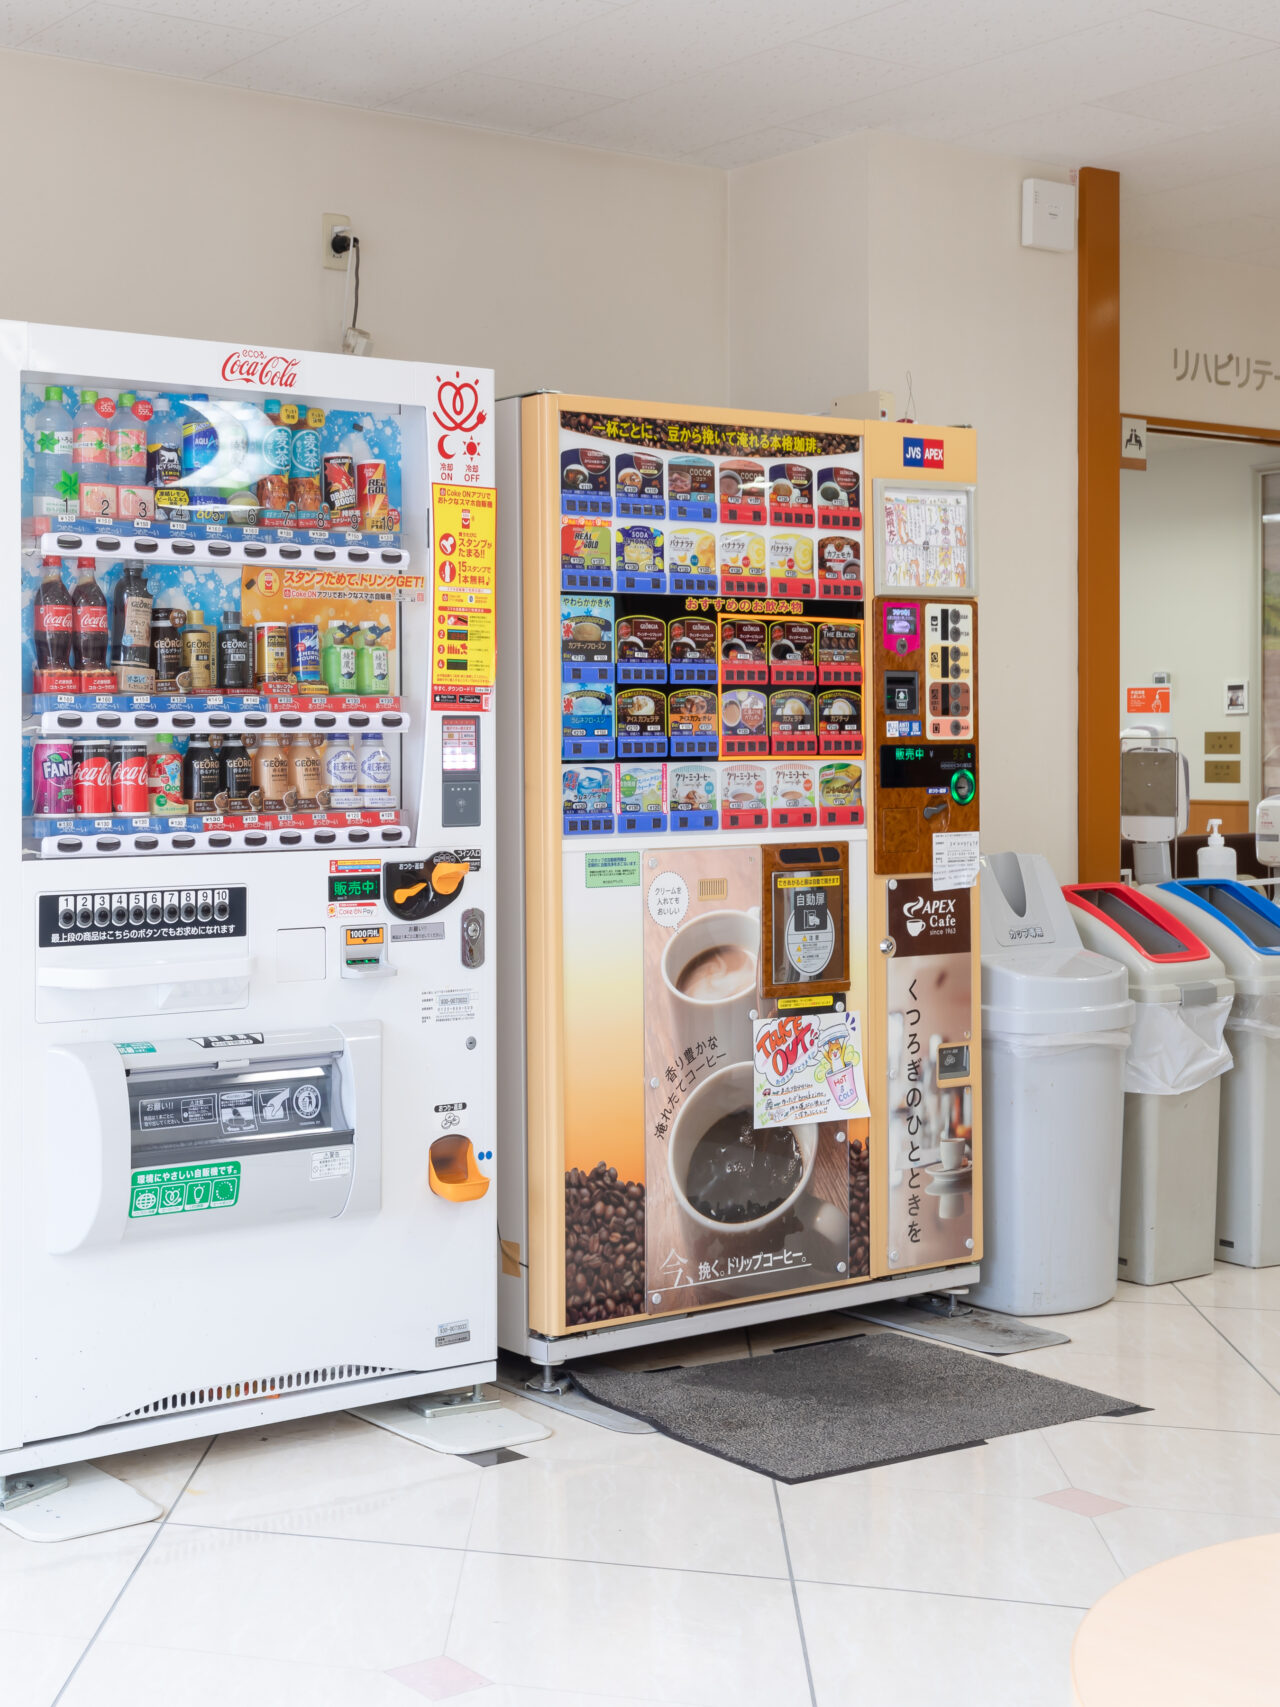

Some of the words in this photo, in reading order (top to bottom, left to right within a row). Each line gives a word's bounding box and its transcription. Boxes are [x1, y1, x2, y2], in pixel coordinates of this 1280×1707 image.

[221, 351, 302, 388] Coca-Cola
[276, 431, 290, 466] 麦茶
[304, 433, 318, 467] 麦茶
[905, 446, 921, 459] JVS
[924, 448, 943, 461] APEX
[441, 473, 453, 481] ON
[464, 473, 480, 482] OFF
[689, 468, 712, 477] COCOA
[101, 499, 110, 516] 2
[138, 501, 147, 518] 3
[175, 504, 184, 520] 4
[212, 506, 220, 522] 5
[248, 508, 257, 525] 6
[282, 510, 290, 525] 7
[317, 512, 325, 528] 8
[351, 514, 359, 529] 9
[381, 516, 394, 531] 10
[458, 538, 492, 549] スタンプが
[584, 541, 598, 549] GOLD
[670, 539, 695, 547] バナナラテ
[771, 544, 793, 552] バナナラテ
[458, 548, 485, 558] たまる!!
[827, 551, 851, 559] カフェモカ
[283, 569, 425, 589] スタンプためて、ドリンクGET!
[563, 597, 611, 608] やわらかかき氷
[685, 597, 804, 614] おすすめのお飲み物
[823, 630, 835, 638] THE
[895, 747, 924, 761] 販売中
[43, 760, 73, 779] FANT
[333, 880, 374, 896] 販売中
[655, 887, 682, 896] クリームを
[64, 898, 69, 907] 1
[81, 897, 88, 906] 2
[99, 896, 106, 906] 3
[116, 895, 123, 905] 4
[134, 894, 140, 904] 5
[151, 894, 158, 903] 6
[169, 893, 175, 902] 7
[185, 892, 192, 902] 8
[201, 892, 208, 901] 9
[216, 891, 227, 900] 10
[656, 897, 680, 906] 入れても
[795, 892, 825, 907] 自動扉
[922, 898, 957, 915] APEX
[362, 908, 374, 916] Pay
[657, 908, 680, 916] おいしい
[929, 914, 957, 927] Cafe
[51, 924, 236, 943] 最上段の商品はこちらのボタンでもお求めになれます
[350, 929, 380, 938] 1000円札
[929, 927, 944, 936] since
[756, 1016, 803, 1059] TAKE
[665, 1035, 719, 1083] 香り豊かな
[834, 1074, 847, 1087] HOT
[654, 1053, 727, 1141] 淹れたてコーヒー
[838, 1089, 855, 1102] COLD
[905, 978, 922, 1244] くつろぎのひとときを
[136, 1165, 238, 1184] 環境にやさしい自販機です。
